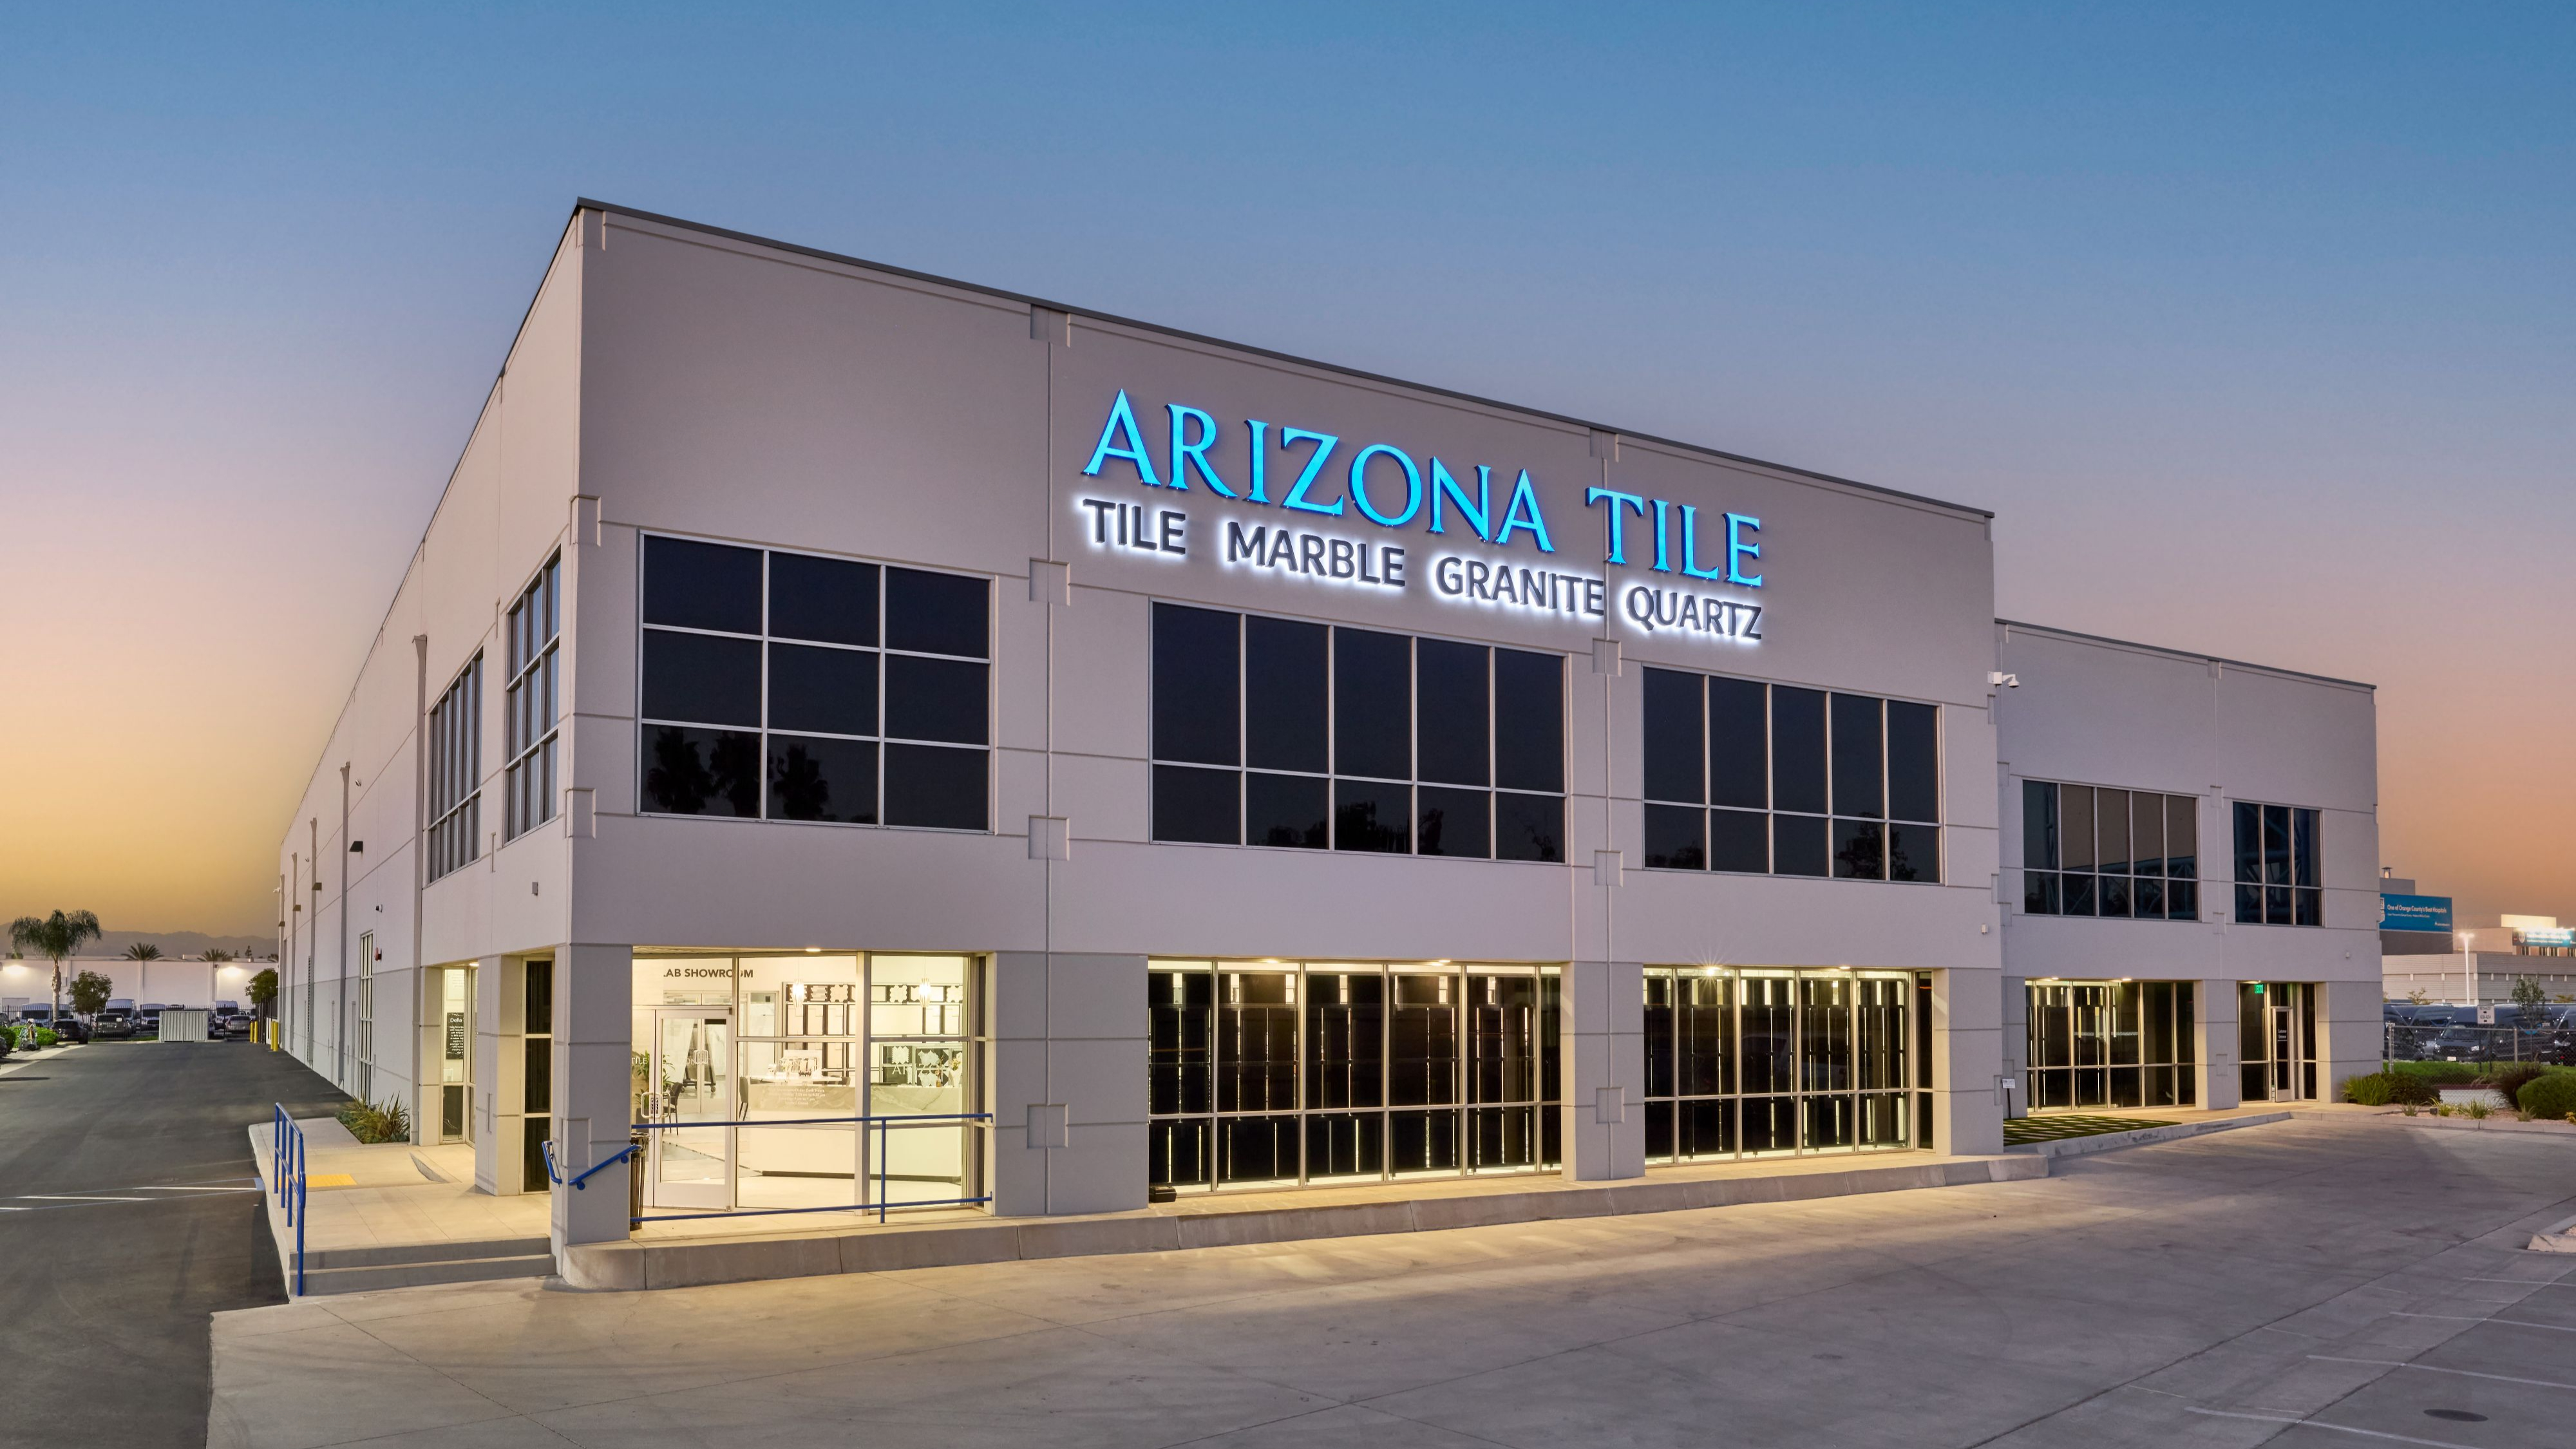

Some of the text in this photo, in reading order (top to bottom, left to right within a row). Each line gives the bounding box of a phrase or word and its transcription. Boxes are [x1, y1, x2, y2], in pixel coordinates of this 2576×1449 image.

[1081, 388, 1763, 587] ARIZONA TILE
[1082, 498, 1762, 639] TILE MARBLE GRANITE QUARTZ
